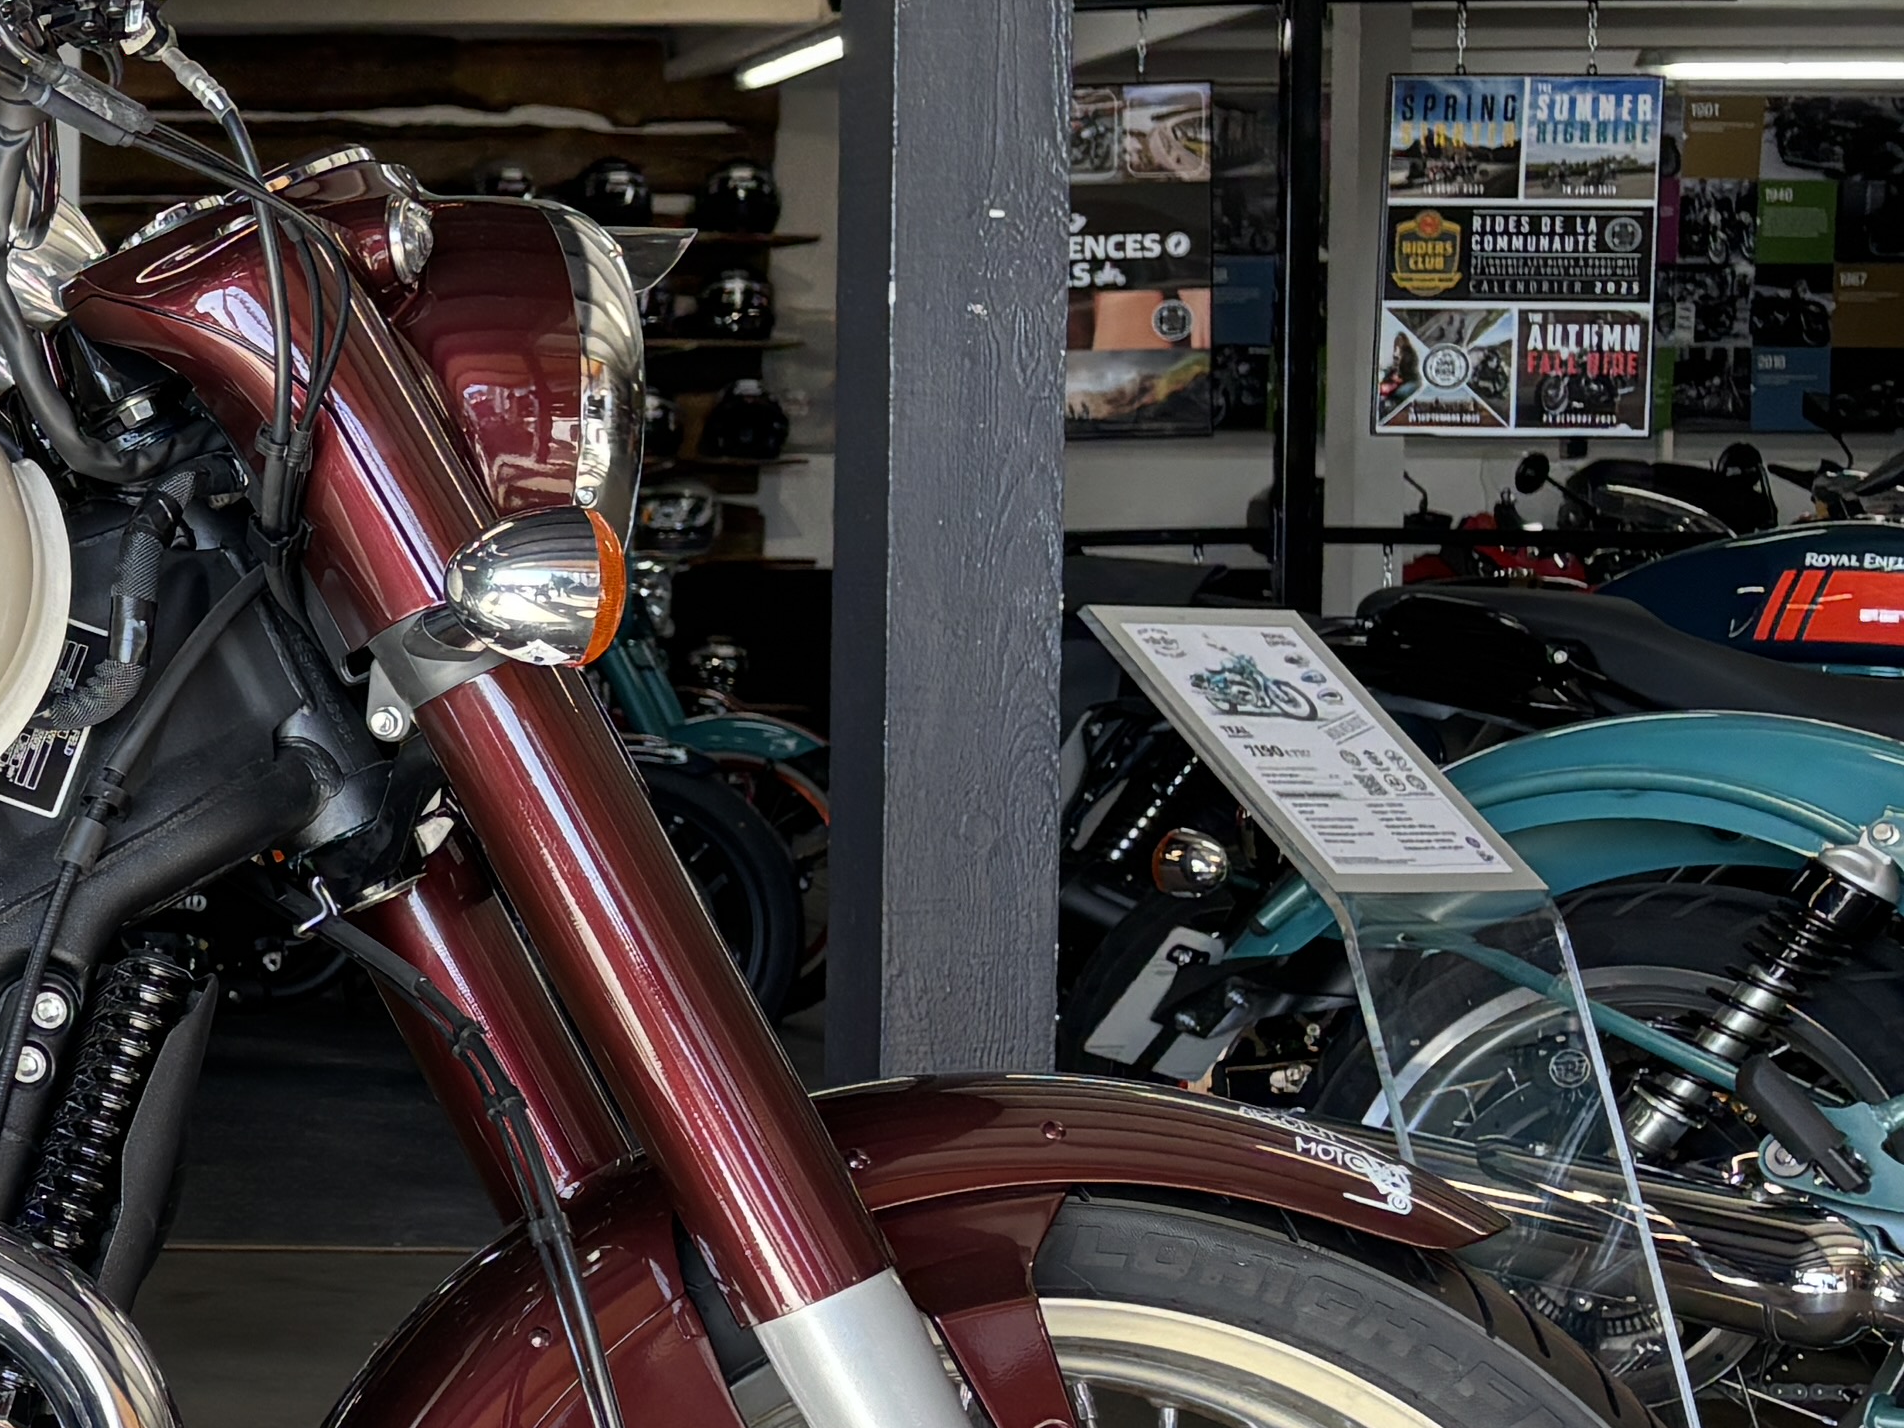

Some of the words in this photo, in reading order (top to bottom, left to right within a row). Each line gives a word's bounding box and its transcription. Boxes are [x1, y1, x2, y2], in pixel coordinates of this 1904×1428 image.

[1401, 93, 1518, 122] SPRING
[1536, 93, 1653, 121] SUMMER
[1472, 216, 1531, 233] RIDES
[1542, 216, 1565, 233] DE
[1576, 216, 1598, 234] LA
[1068, 233, 1162, 260] ENCES
[1469, 280, 1583, 294] CALENDRIER
[1805, 552, 1860, 567] ROYAL
